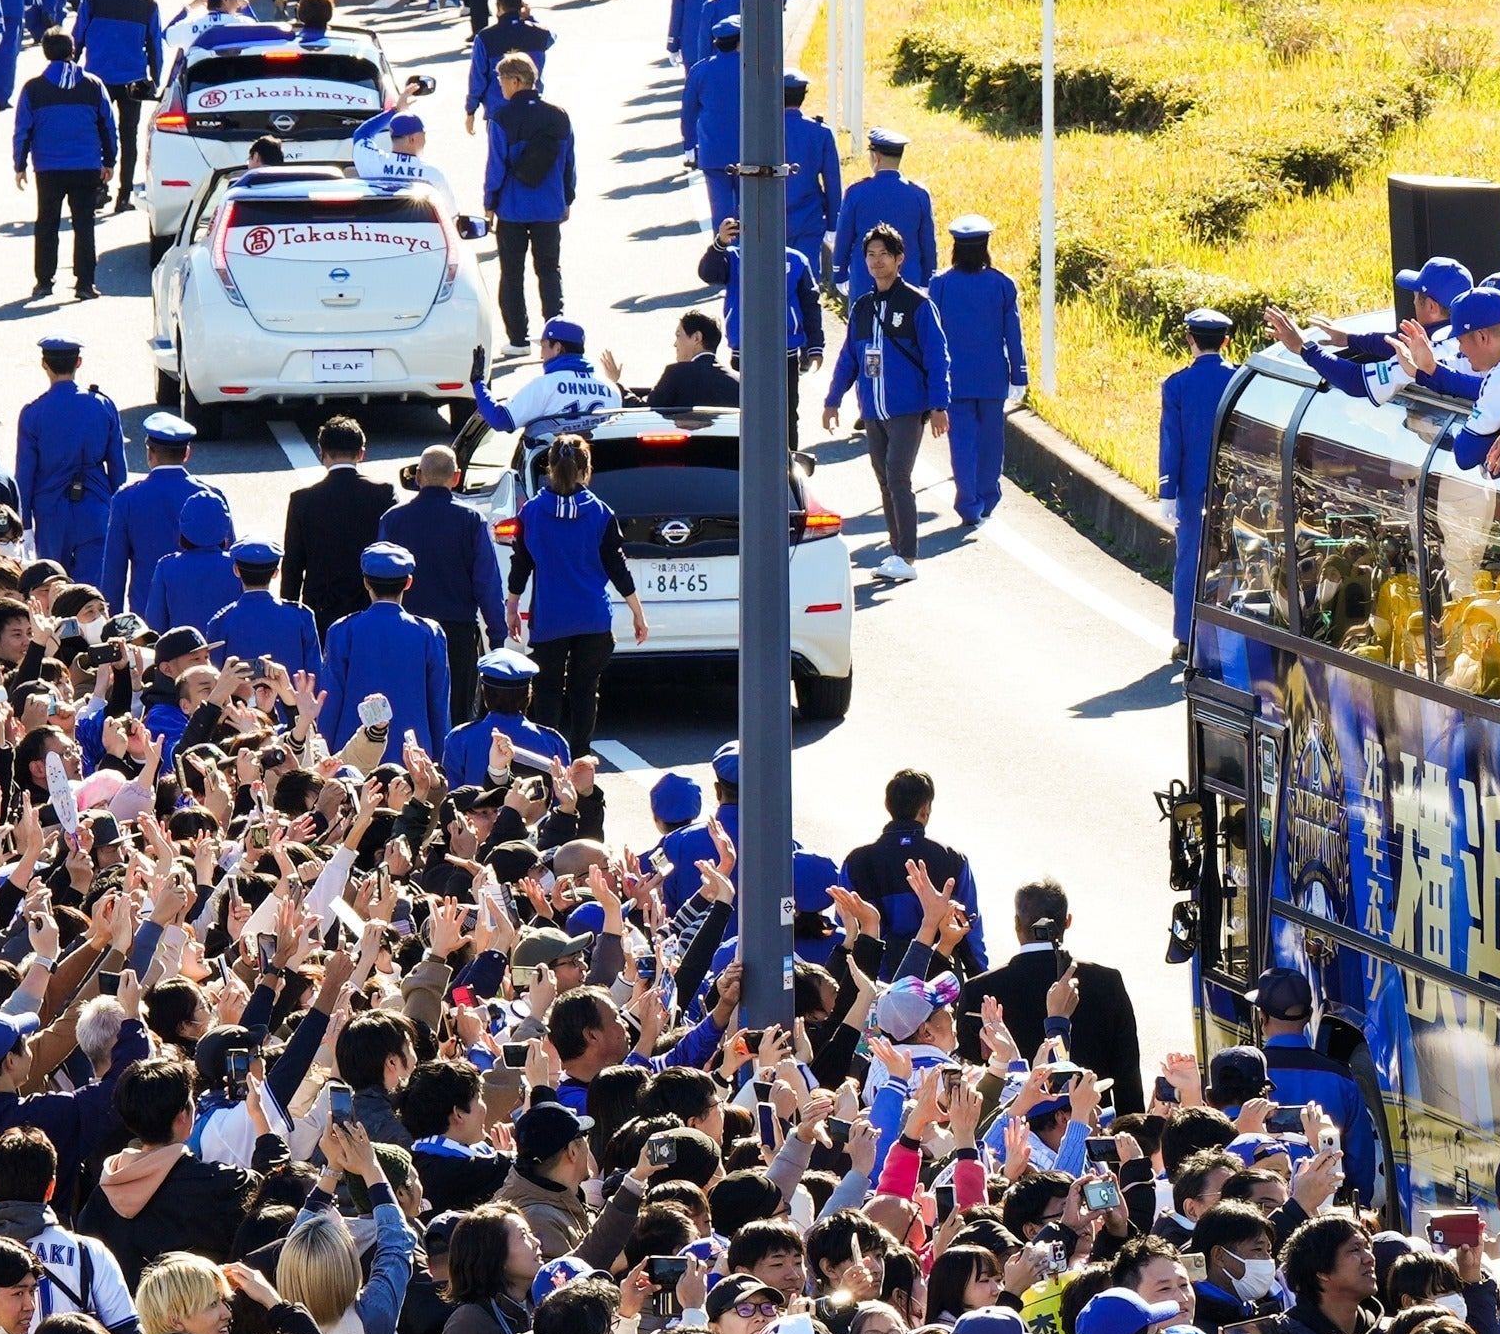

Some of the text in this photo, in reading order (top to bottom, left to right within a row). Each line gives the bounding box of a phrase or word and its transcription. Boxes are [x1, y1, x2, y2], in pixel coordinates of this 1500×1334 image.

[229, 85, 369, 106] Takashimaya
[383, 165, 424, 178] MAKI
[278, 224, 433, 253] Takashimaya
[321, 361, 366, 372] LEAF
[556, 381, 613, 399] OHNUKI
[656, 575, 709, 593] 84-65
